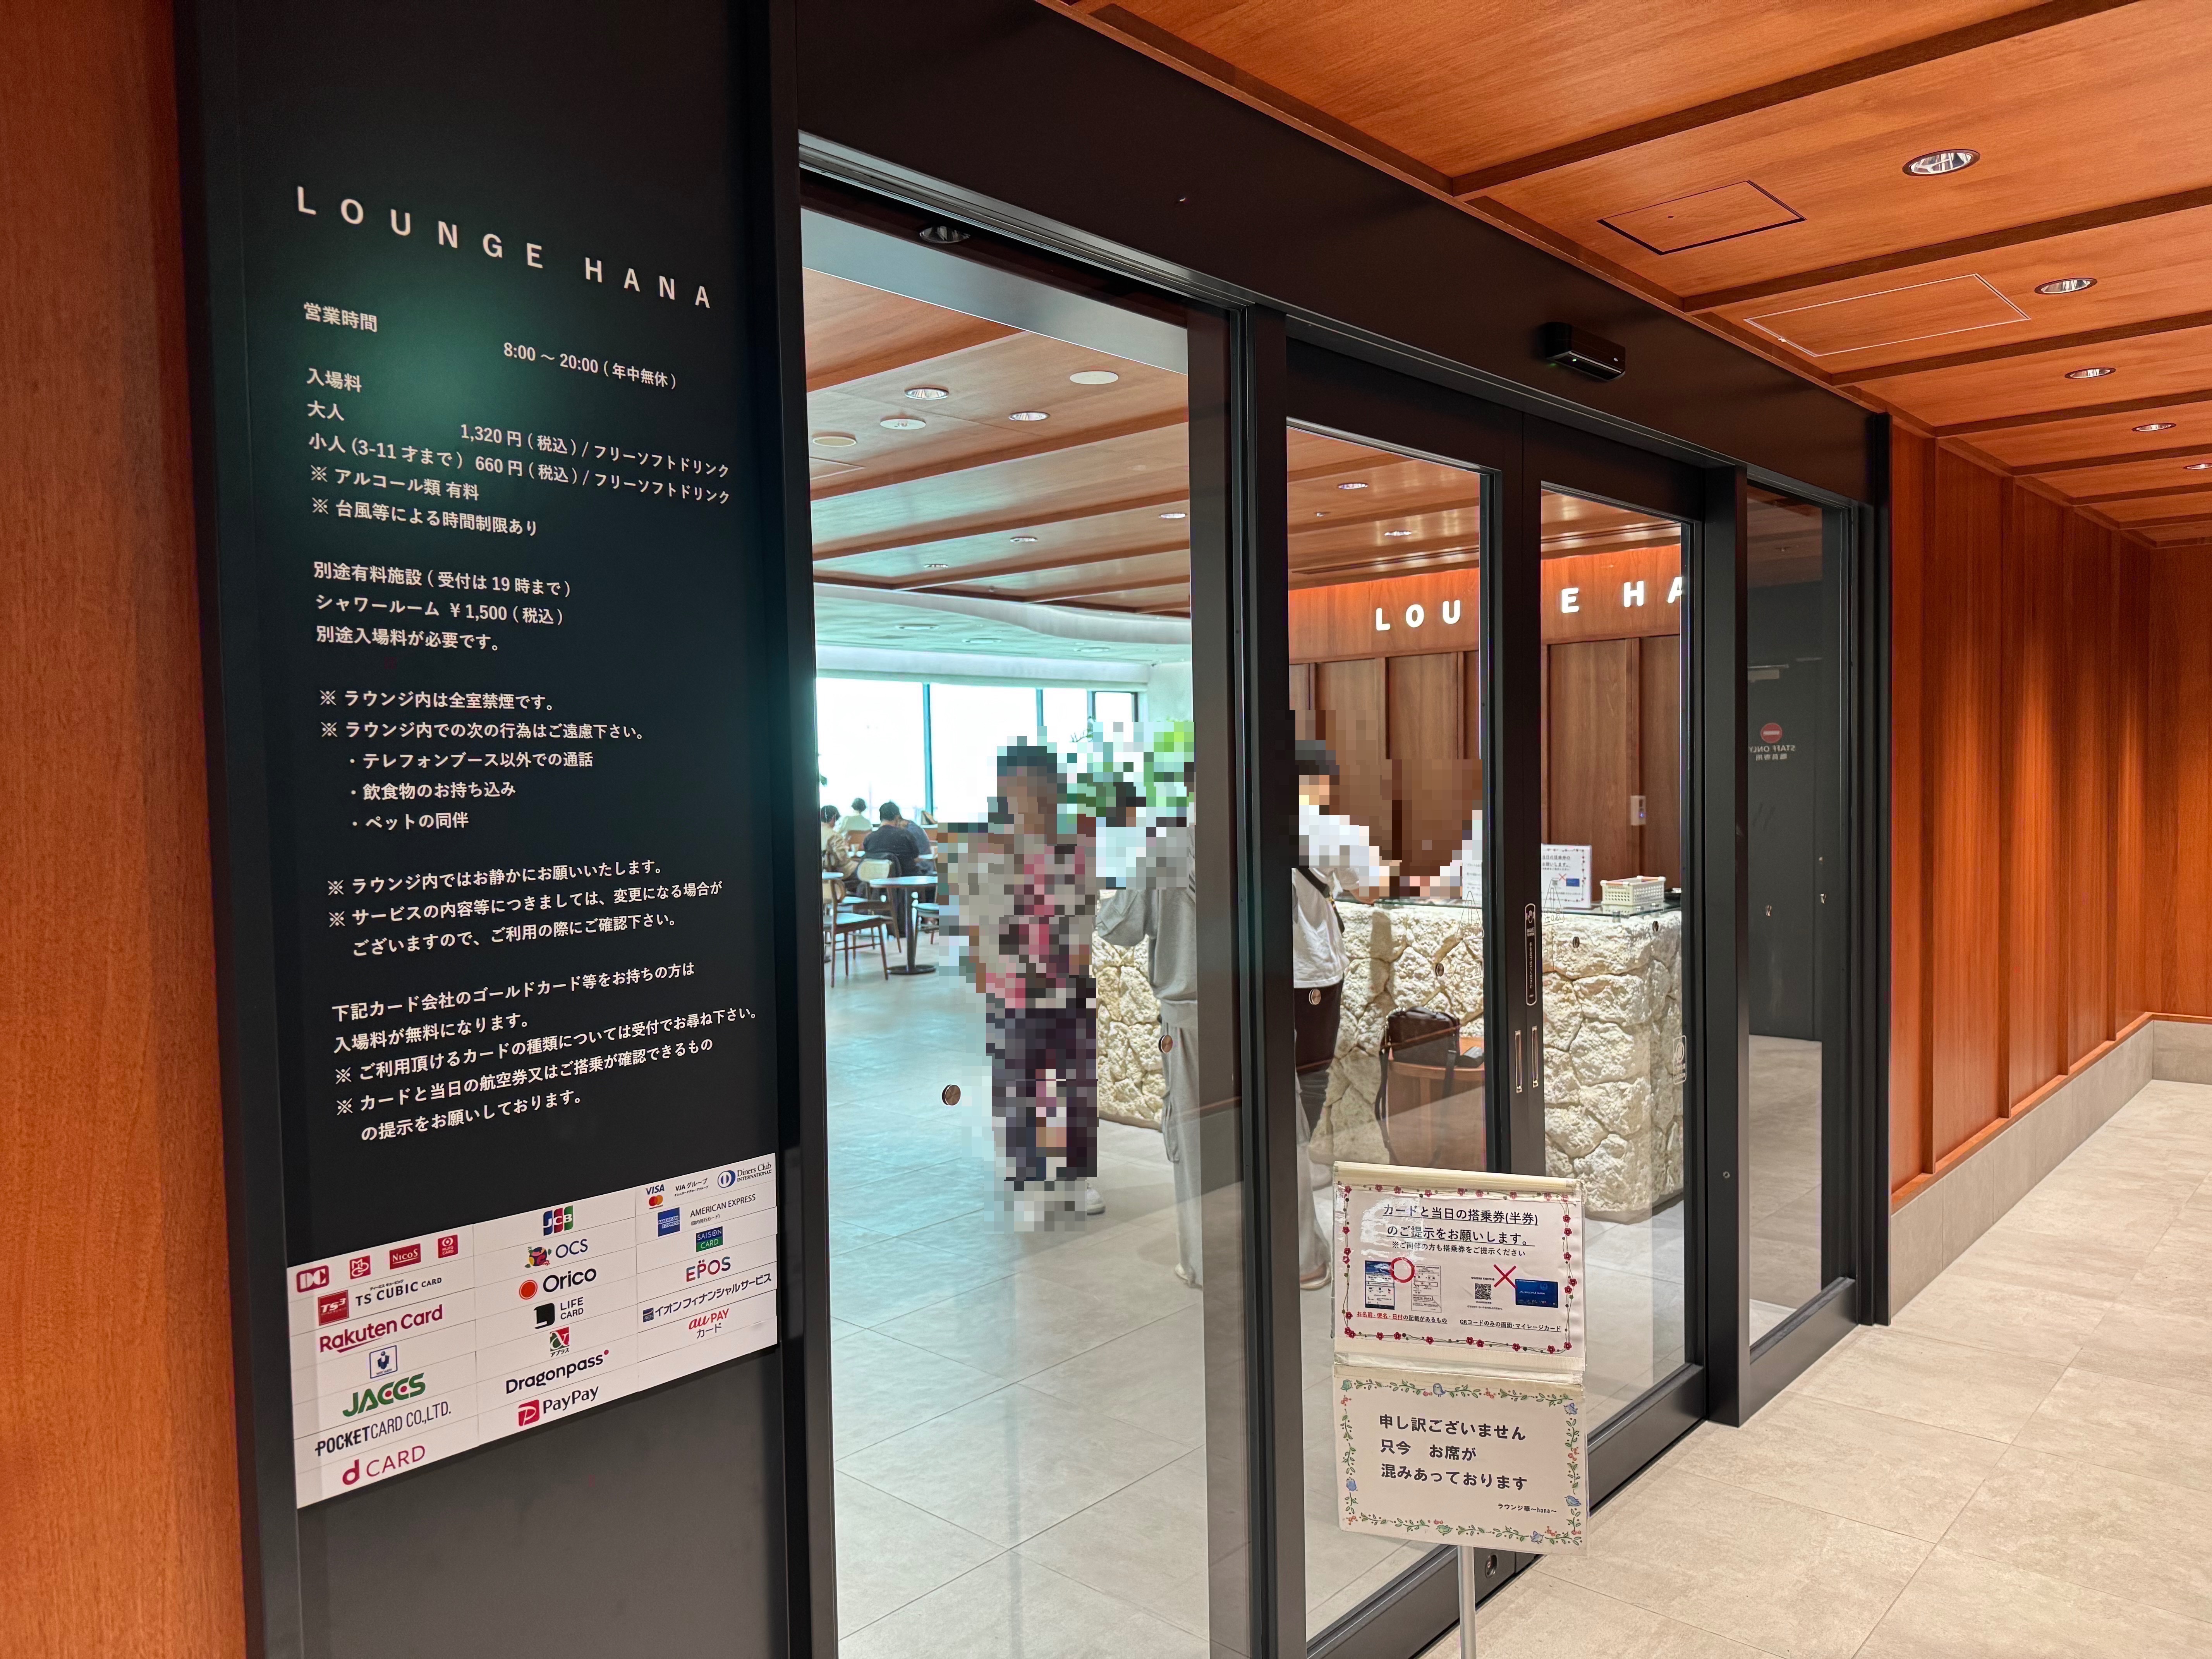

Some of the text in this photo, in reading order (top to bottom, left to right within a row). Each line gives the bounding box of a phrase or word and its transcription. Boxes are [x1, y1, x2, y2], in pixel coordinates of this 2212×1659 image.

[297, 186, 710, 308] LOUNGE HANA
[304, 302, 377, 333] 営業時間
[307, 368, 362, 393] 入場料
[307, 400, 344, 421] 大人
[335, 469, 441, 496] アルコール類
[446, 481, 479, 501] 有料
[336, 499, 536, 536] 台風等による時間制限あり
[316, 594, 439, 616] シャワールーム
[317, 625, 498, 651] 別途入場料が必要です。
[345, 690, 552, 711] ラウンジ内は全室禁煙です。
[346, 721, 642, 739] ラウンジ内での次の行為はご遠慮下さい。
[352, 859, 660, 894] ラウンジ内ではお静かにお願いいたします。
[352, 880, 723, 925] サービスの内容等につきましては、変更になる場合が
[354, 913, 675, 956] ございますので、ご利用の際にご確認下さい。
[332, 962, 694, 1022] 下記カード会社のゴールドカード等をお持ちの方は
[333, 1013, 527, 1054] 入場料が無料になります。
[360, 1008, 756, 1080] ご利用頂けるカードの種類については受付でお尋ね下さい。
[361, 1039, 713, 1111] カードと当日の航空券又はご搭乗が確認できるもの
[361, 1090, 580, 1140] の提示をお願いしております。
[737, 1162, 771, 1176] Diners Club
[646, 1184, 665, 1195] VISA
[687, 1178, 708, 1188] グループ
[690, 1194, 756, 1218] AMERICAN EXPRESS
[1383, 1204, 1538, 1224] カードと当日の搭乗券(半券)
[697, 1228, 722, 1240] SAISON
[701, 1239, 719, 1249] CARD
[1387, 1226, 1528, 1246] のご提示をお願いします。
[555, 1238, 588, 1258] OCS
[356, 1277, 442, 1306] TS CUBIC CARD
[543, 1268, 597, 1293] Orico
[560, 1297, 584, 1310] LIFE
[655, 1273, 772, 1317] イオンフィナンシャルサービス
[560, 1308, 584, 1320] CARD
[689, 1308, 729, 1329] au PAY
[1460, 1319, 1562, 1332] QRコードのみの画面・マイレージカード
[319, 1304, 443, 1353] Rakuten Card
[697, 1323, 722, 1339] カード
[550, 1348, 570, 1357] アプラス
[506, 1354, 603, 1394] Dragonpass
[342, 1372, 426, 1417] JACCS
[543, 1386, 599, 1414] PayPay
[315, 1401, 451, 1457] POCKETCARD CO.,LTD.
[1379, 1414, 1526, 1441] 申し訳ございません
[1381, 1439, 1477, 1461] 只今 お席が
[342, 1445, 426, 1485] d CARD
[1381, 1463, 1527, 1491] 混みあっております
